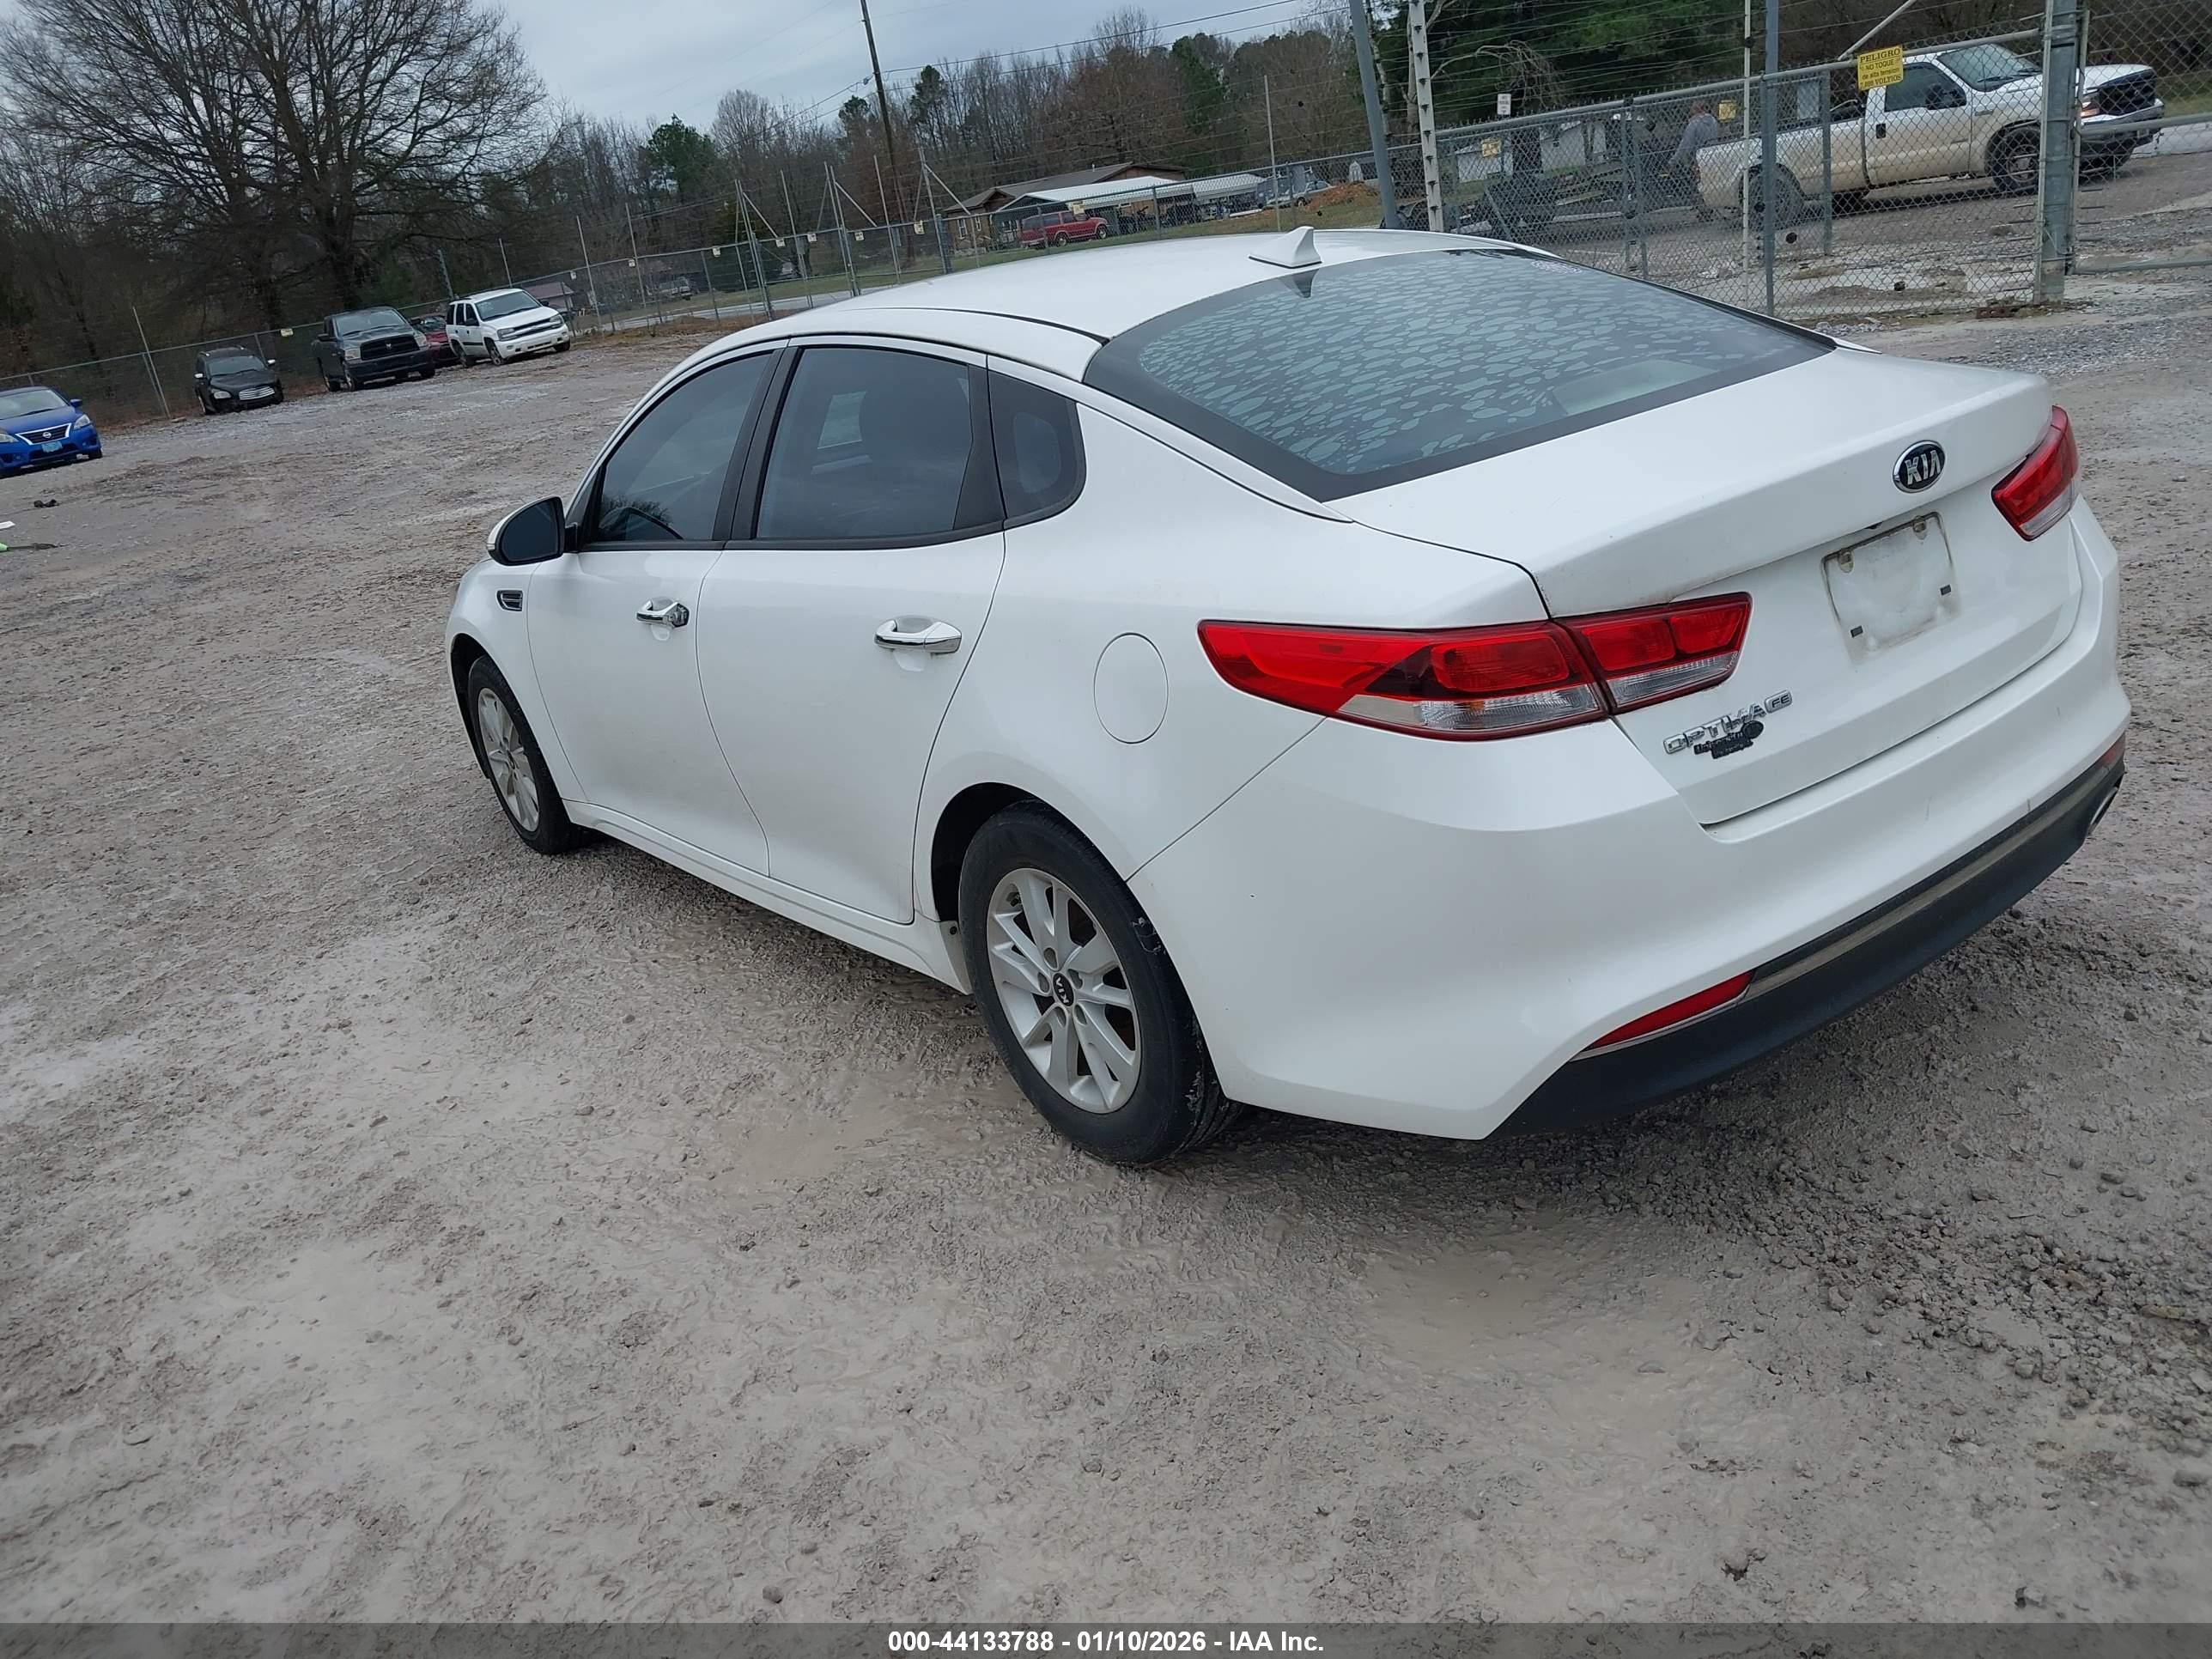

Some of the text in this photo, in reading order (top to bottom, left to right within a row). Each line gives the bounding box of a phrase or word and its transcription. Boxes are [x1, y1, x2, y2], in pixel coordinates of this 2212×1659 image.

[1860, 48, 1900, 63] PELIGRO
[1875, 59, 1894, 69] TOQUE
[1875, 75, 1901, 85] VOLTIOS
[1904, 449, 1942, 485] KIA
[1056, 976, 1070, 1004] KIA
